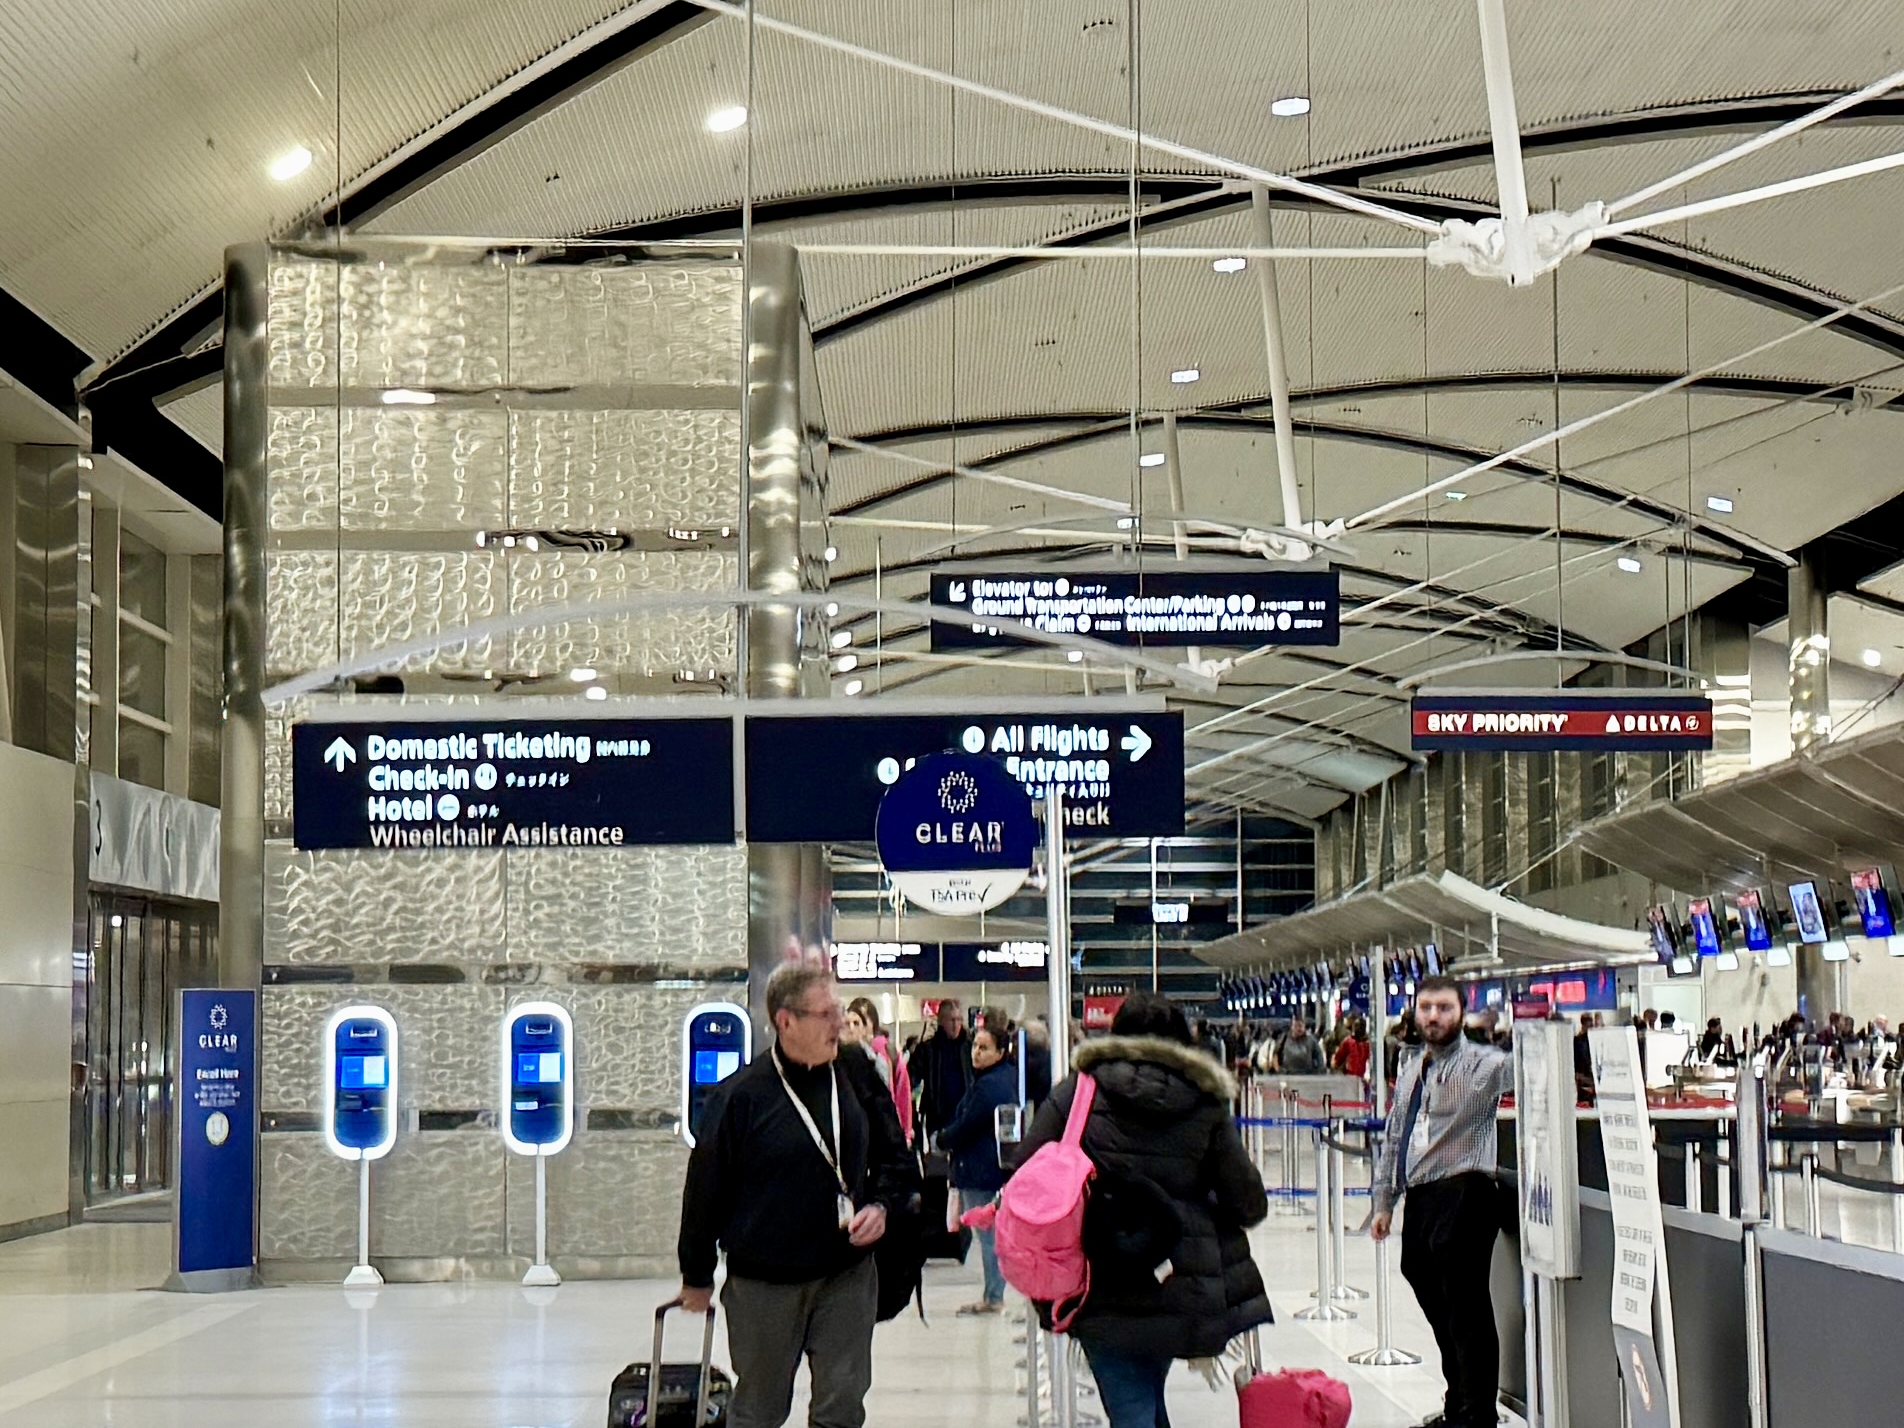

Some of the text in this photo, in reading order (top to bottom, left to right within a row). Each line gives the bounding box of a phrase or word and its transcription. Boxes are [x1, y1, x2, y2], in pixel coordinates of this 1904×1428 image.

[971, 597, 1024, 616] Ground
[1025, 595, 1124, 616] Transportation
[1427, 713, 1565, 733] SKY PRIORITY
[1624, 714, 1682, 732] DELTA
[367, 734, 478, 760] Domestic
[482, 732, 591, 763] Ticketing
[991, 724, 1110, 757] All Flights
[367, 764, 470, 791] Check-in
[1006, 756, 1110, 783] Entrance
[367, 794, 433, 821] Hotel
[369, 821, 624, 847] Wheelchair Assistance
[915, 821, 1002, 844] CLEAR
